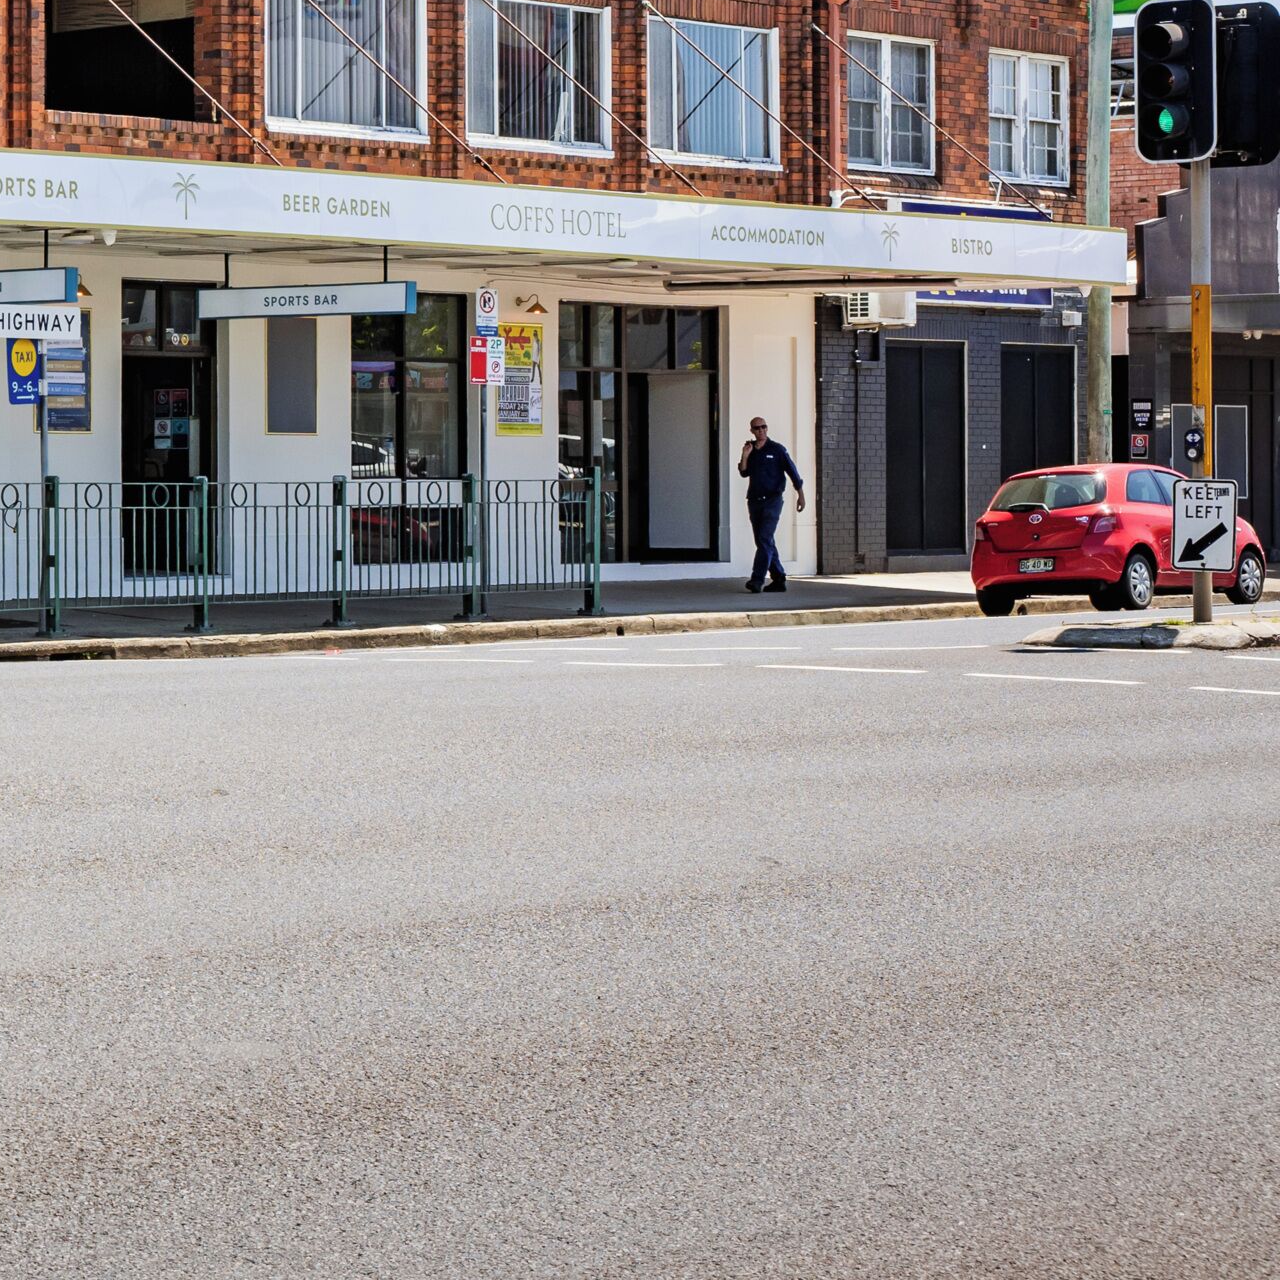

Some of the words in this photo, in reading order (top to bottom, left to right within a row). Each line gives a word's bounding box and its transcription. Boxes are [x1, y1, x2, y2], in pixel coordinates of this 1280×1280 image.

[44, 179, 79, 199] BAR
[283, 194, 320, 213] BEER
[327, 197, 391, 217] GARDEN
[490, 203, 555, 234] COFFS
[561, 209, 627, 238] HOTEL
[711, 225, 825, 246] ACCOMMODATION
[951, 238, 993, 256] BISTRO
[263, 295, 309, 307] SPORTS
[314, 294, 338, 306] BAR
[490, 339, 502, 350] 2P
[15, 351, 33, 363] TAXI
[1182, 486, 1219, 501] KEE
[1185, 504, 1223, 519] LEFT
